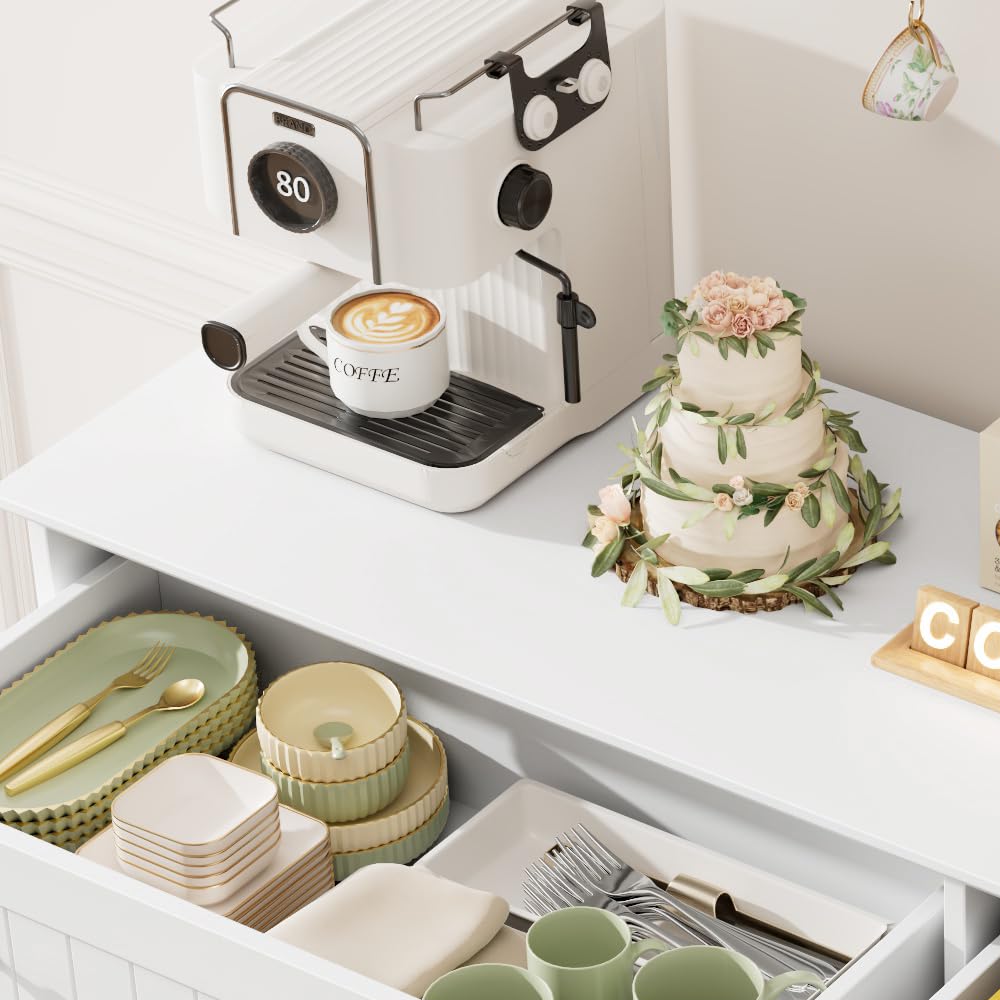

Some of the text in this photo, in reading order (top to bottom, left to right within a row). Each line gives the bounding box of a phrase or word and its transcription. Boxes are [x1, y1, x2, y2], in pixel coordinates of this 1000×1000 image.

[276, 170, 310, 203] 80
[333, 357, 400, 383] COFFE
[994, 556, 1000, 565] 3
